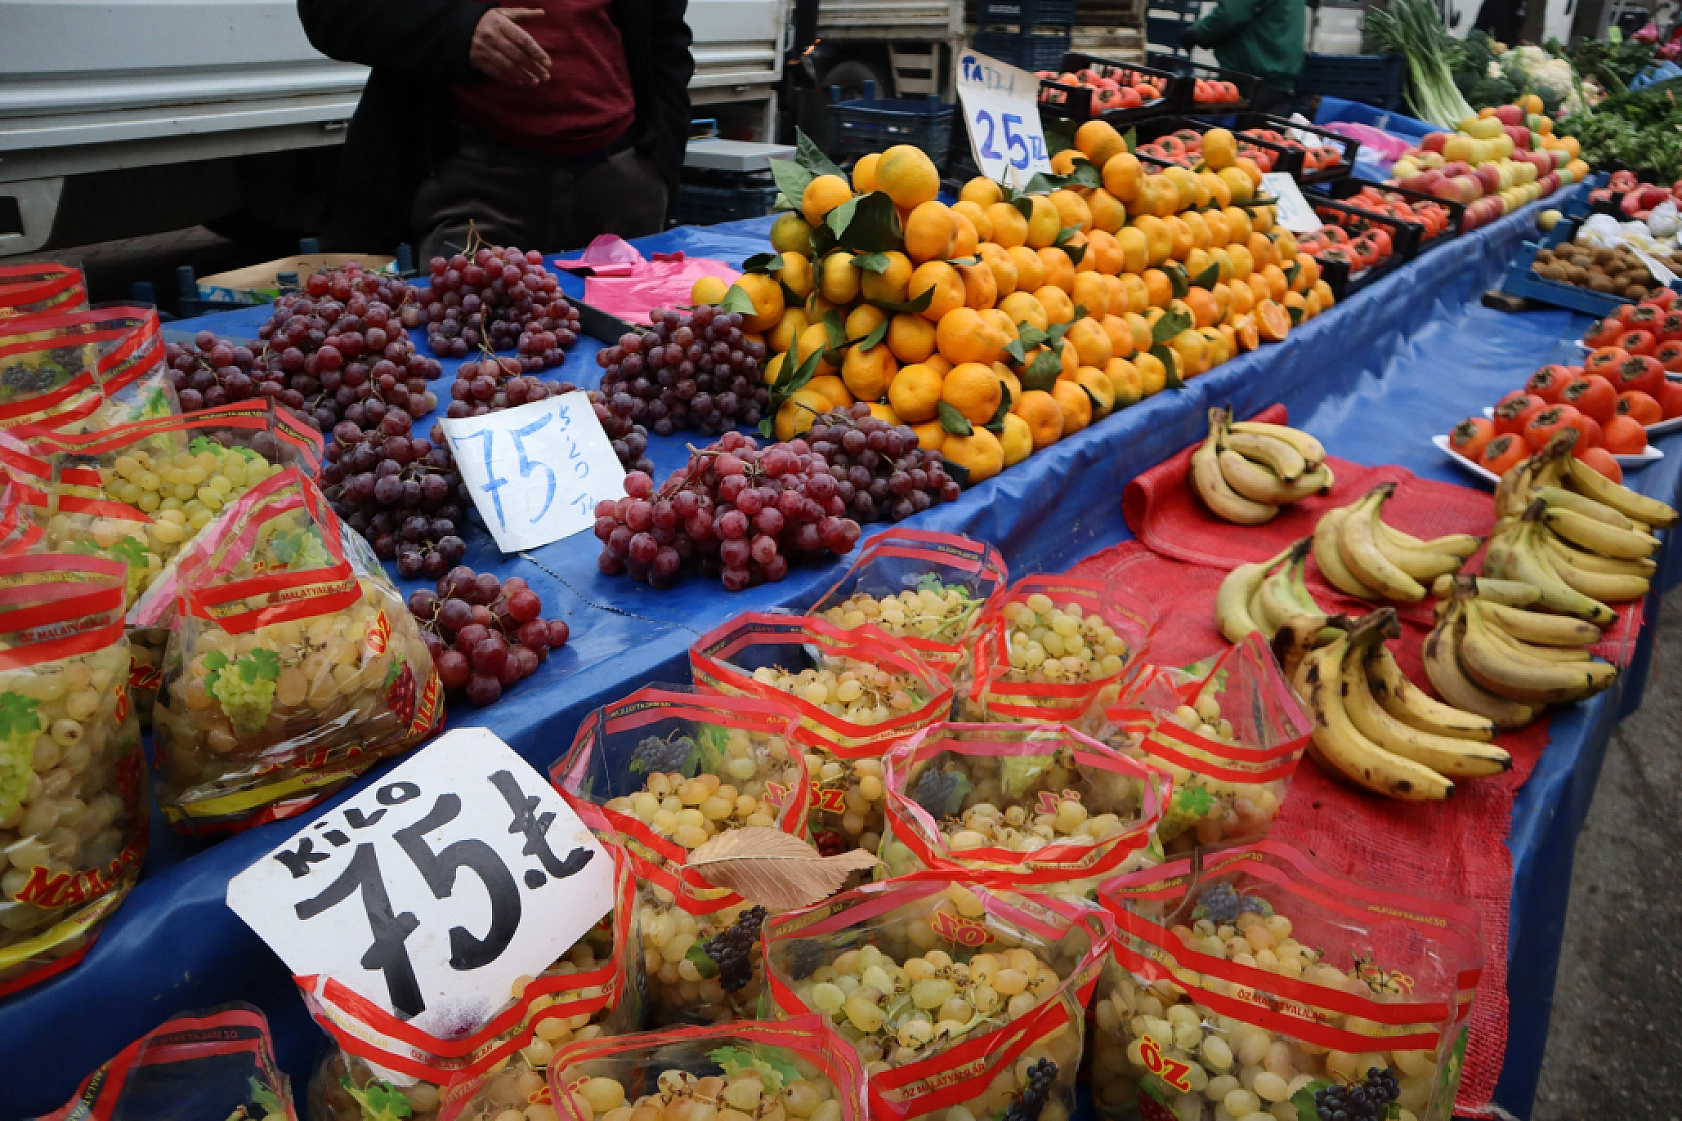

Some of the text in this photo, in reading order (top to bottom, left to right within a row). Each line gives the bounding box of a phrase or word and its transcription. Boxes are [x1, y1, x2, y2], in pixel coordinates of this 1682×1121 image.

[975, 108, 1029, 171] 25
[452, 412, 557, 533] 75
[294, 793, 522, 1017] 75
[1139, 1034, 1192, 1094] ÖZ
